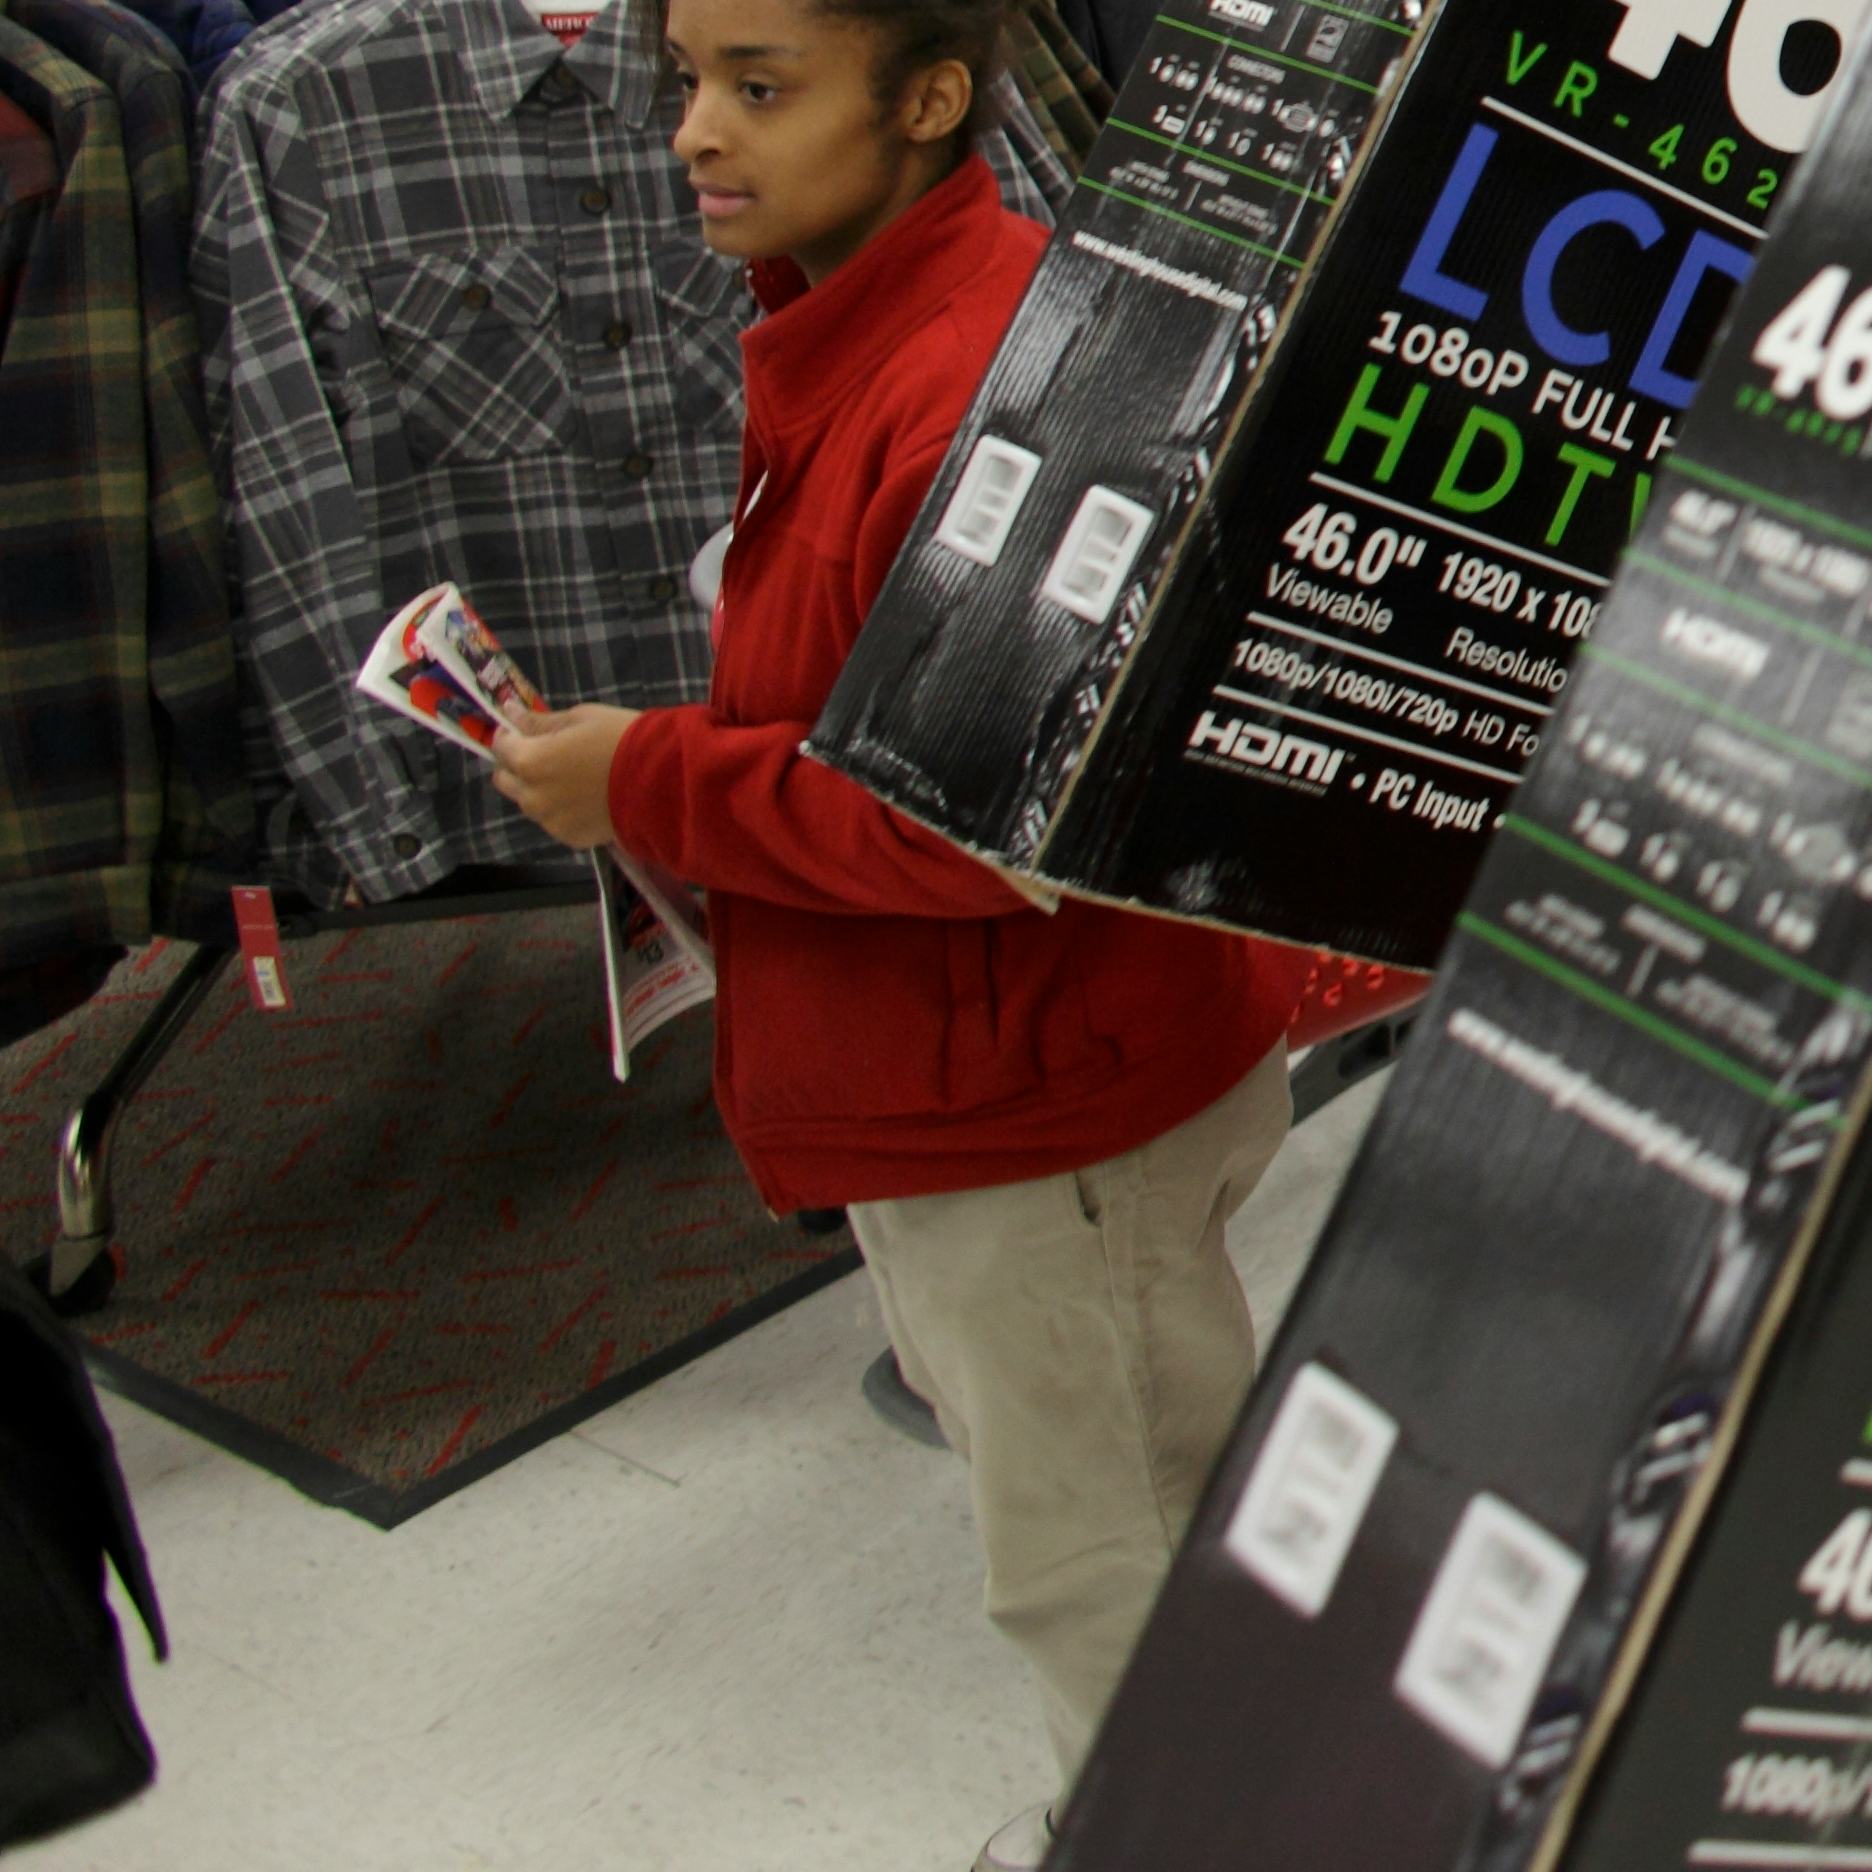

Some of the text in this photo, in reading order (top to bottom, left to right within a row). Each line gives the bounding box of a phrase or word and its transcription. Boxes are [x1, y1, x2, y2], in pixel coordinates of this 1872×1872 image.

[1501, 30, 1779, 212] VR-462
[1399, 122, 1755, 411] LCD
[1366, 309, 1530, 399] 1080P
[1530, 369, 1637, 453] FULL
[1264, 561, 1395, 635] Viewable
[1281, 501, 1430, 587] 46.0"
[1438, 550, 1522, 614] 1920
[1516, 584, 1549, 625] x
[1230, 637, 1541, 758] 1080p/1080i/720p HD Fo
[1443, 625, 1570, 695] Resolutio
[1187, 709, 1348, 785] HDMI
[1367, 767, 1418, 812] PC
[1411, 780, 1493, 834] Input
